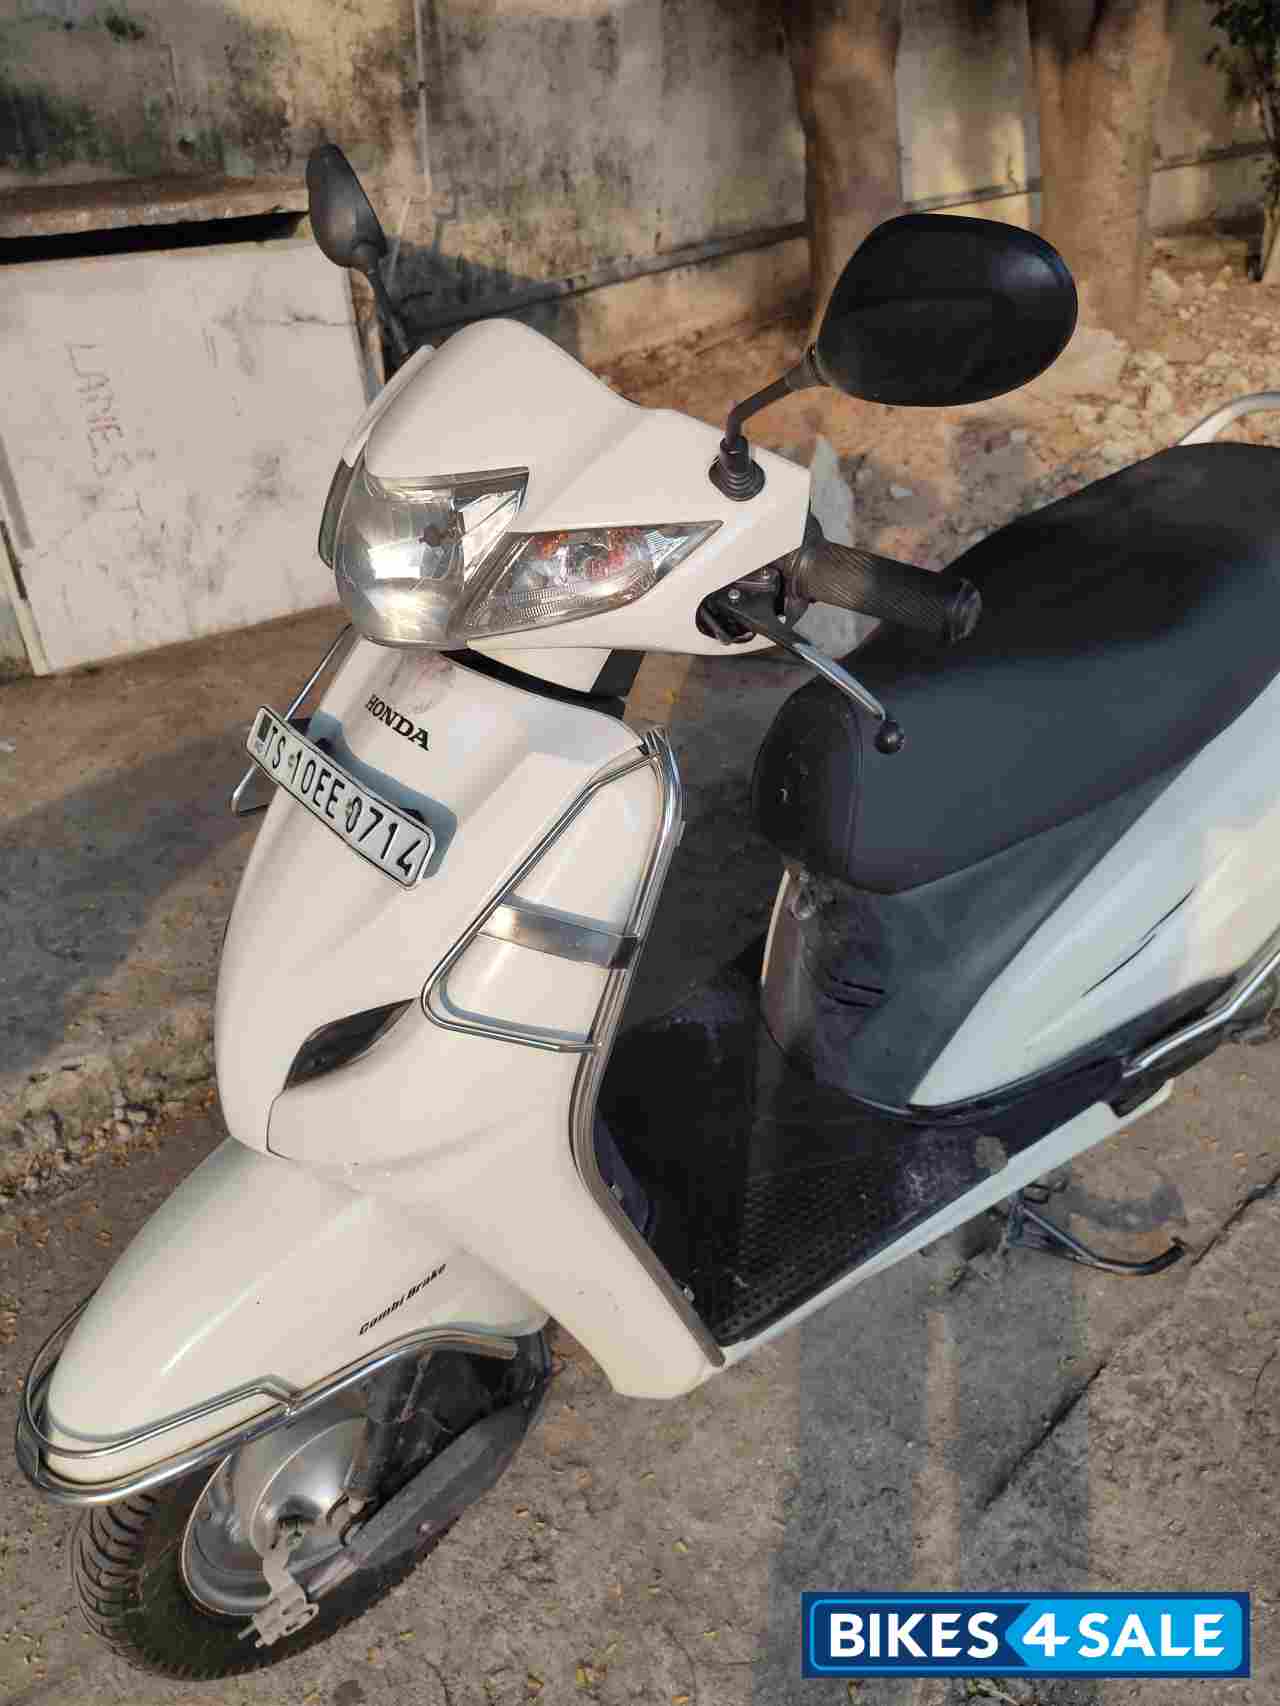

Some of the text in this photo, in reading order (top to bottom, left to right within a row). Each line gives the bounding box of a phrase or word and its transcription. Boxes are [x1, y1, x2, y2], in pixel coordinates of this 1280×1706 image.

[366, 695, 431, 751] HONDA
[358, 1263, 447, 1336] Combi Brake
